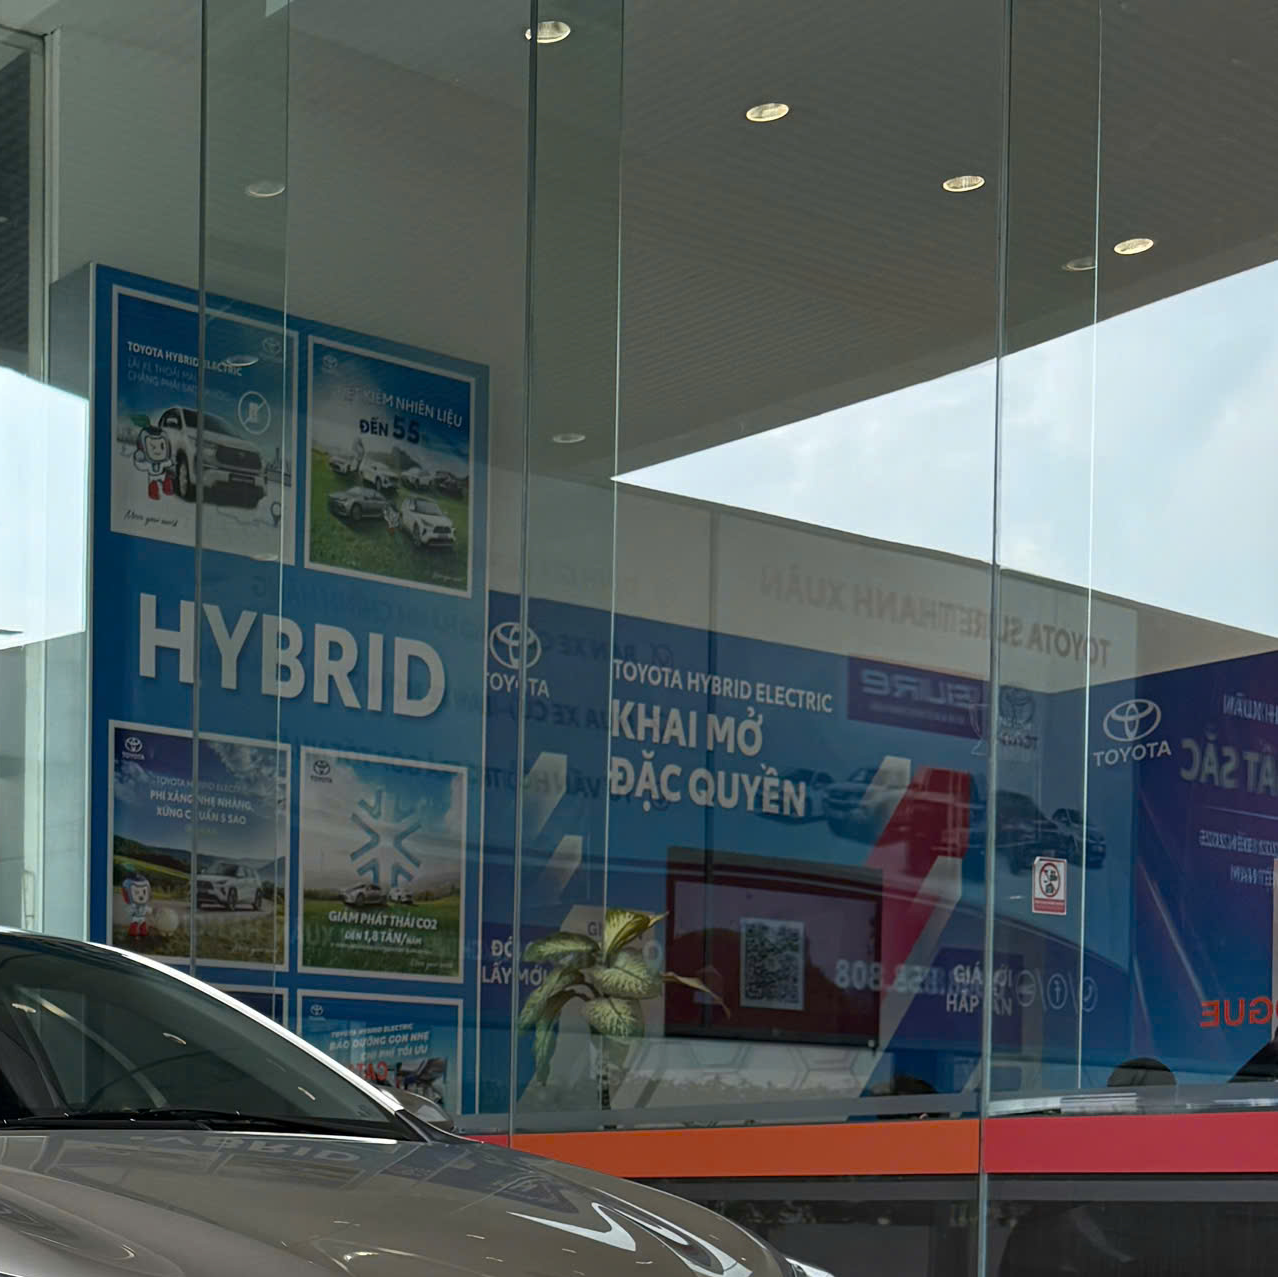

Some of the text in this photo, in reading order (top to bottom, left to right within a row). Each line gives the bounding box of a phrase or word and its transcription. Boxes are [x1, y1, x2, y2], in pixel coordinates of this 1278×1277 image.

[127, 341, 163, 359] TOYOTA
[165, 351, 199, 367] HYBRID
[395, 397, 434, 419] NHIÊN
[139, 593, 446, 718] HYBRID
[485, 671, 550, 698] OYTA
[612, 658, 834, 714] TOYOTA HYBRID ELECTRIC
[611, 698, 698, 748] KHAI
[706, 706, 764, 757] MỞ
[1091, 740, 1172, 768] TOYOTA
[609, 750, 683, 813] ĐẶC
[688, 762, 808, 818] QUYỀN
[185, 809, 219, 823] CUẨN
[328, 910, 438, 930] GIẢM PHÁT THẢI CO2
[482, 962, 511, 984] LẤY
